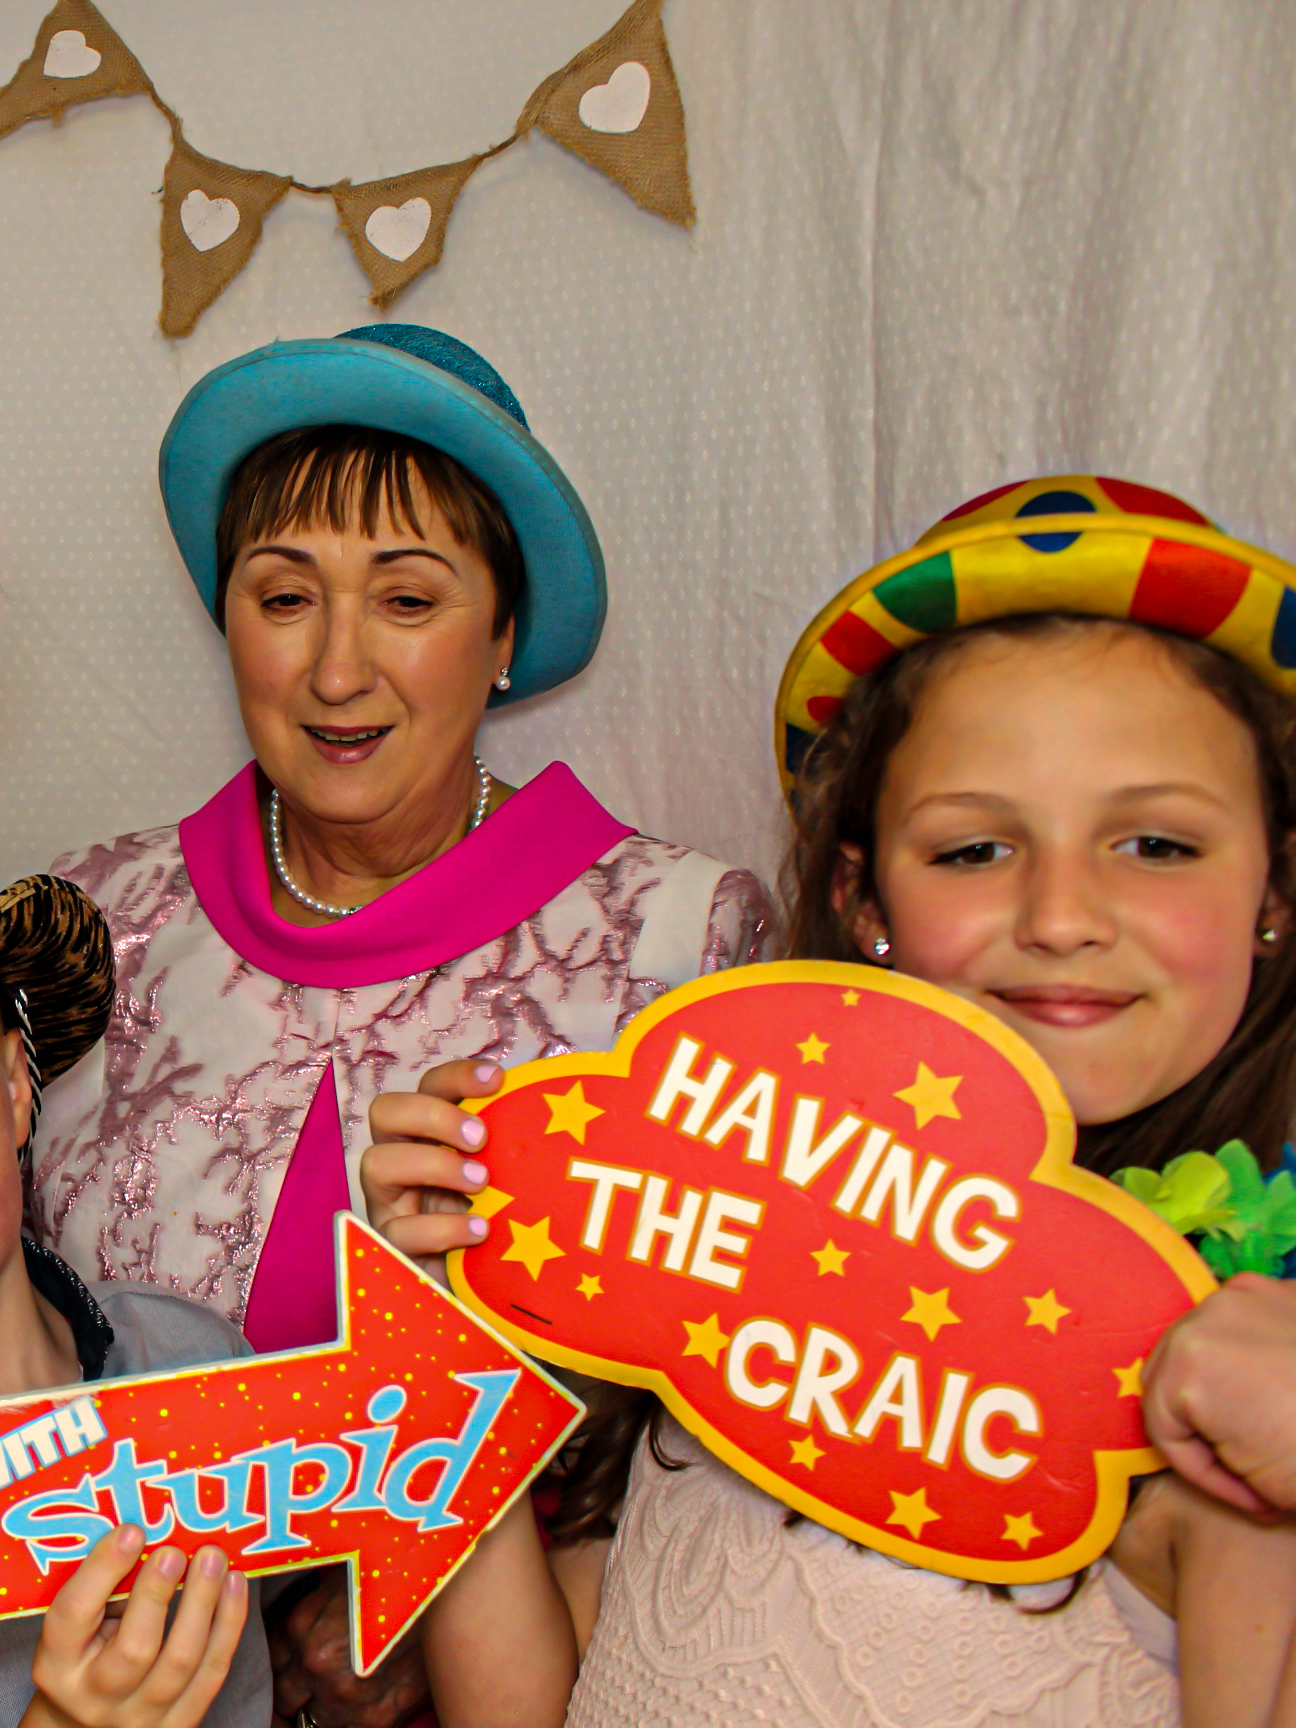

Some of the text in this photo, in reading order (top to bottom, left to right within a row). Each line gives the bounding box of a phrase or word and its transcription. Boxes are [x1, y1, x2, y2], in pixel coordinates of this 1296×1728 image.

[569, 1160, 764, 1290] THE
[649, 1036, 1020, 1271] HAVING
[1, 1369, 521, 1576] stupid
[726, 1319, 1040, 1480] CRAIC
